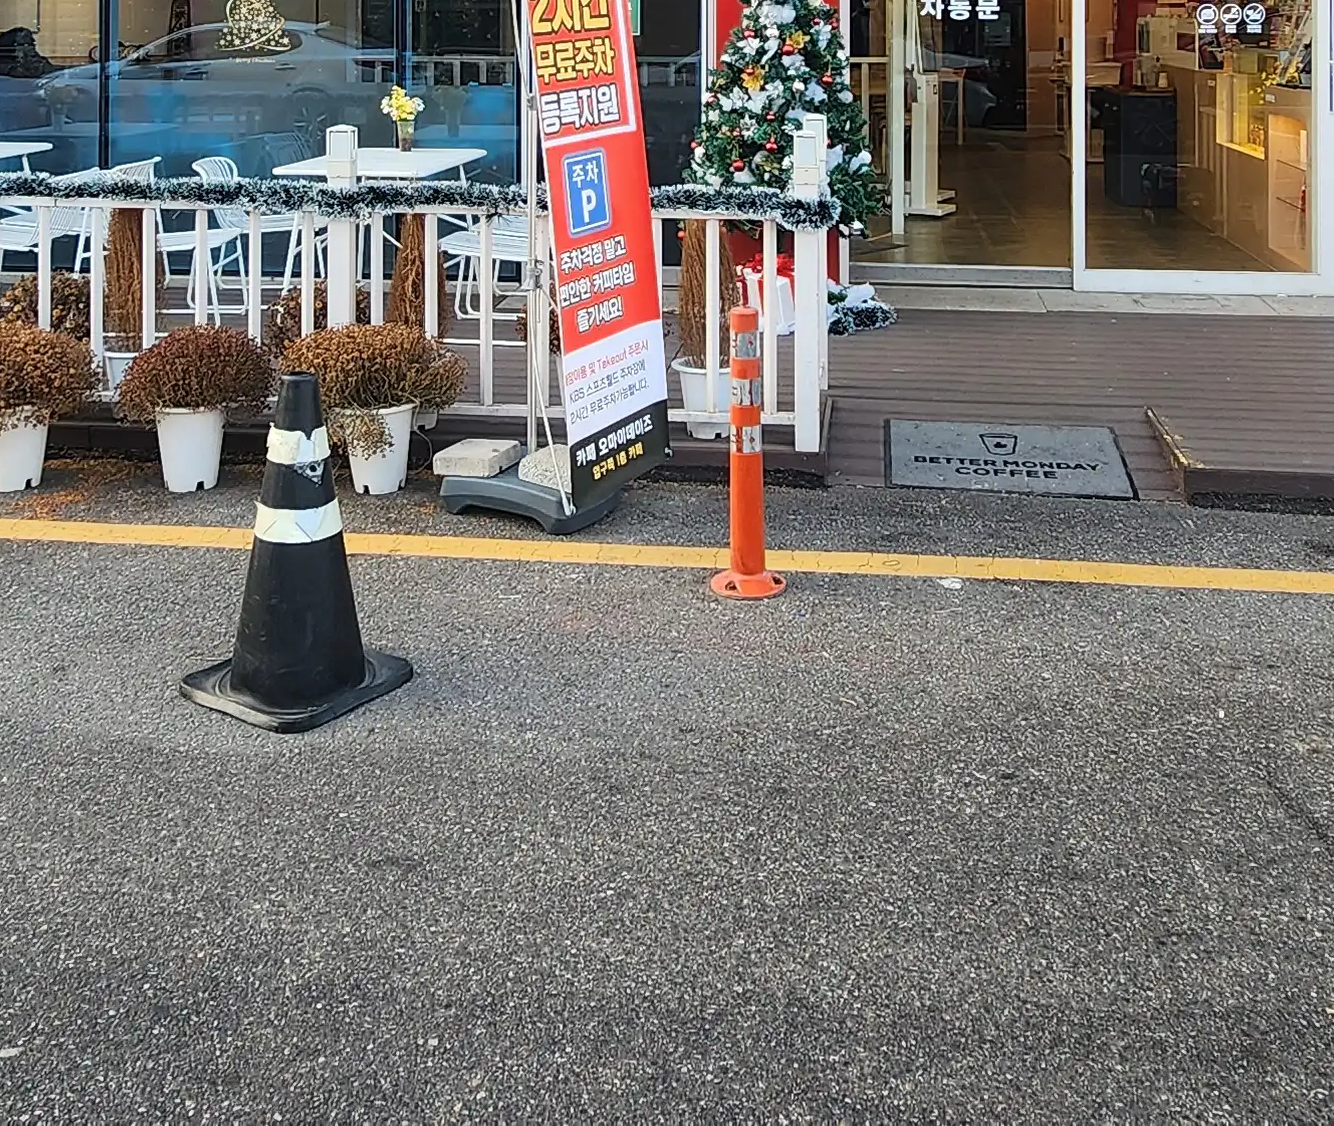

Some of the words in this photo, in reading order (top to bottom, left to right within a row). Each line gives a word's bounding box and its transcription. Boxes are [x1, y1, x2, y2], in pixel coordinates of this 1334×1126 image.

[535, 37, 615, 85] 무료주차
[540, 83, 620, 135] 등록지원
[572, 160, 598, 188] 주차
[581, 188, 597, 223] P
[560, 241, 604, 275] 주차걱정
[604, 234, 627, 261] 말고
[559, 275, 592, 308] 편안한
[592, 260, 636, 294] 커피타임
[577, 295, 624, 334] 즐기세요!
[570, 387, 585, 404] KBS
[570, 406, 589, 425] 2시간
[576, 442, 596, 467] 카페
[598, 414, 653, 456] 오마이데이즈
[913, 455, 997, 468] BETTER
[1002, 459, 1100, 472] MONDAY
[954, 467, 1059, 480] COFFEE
